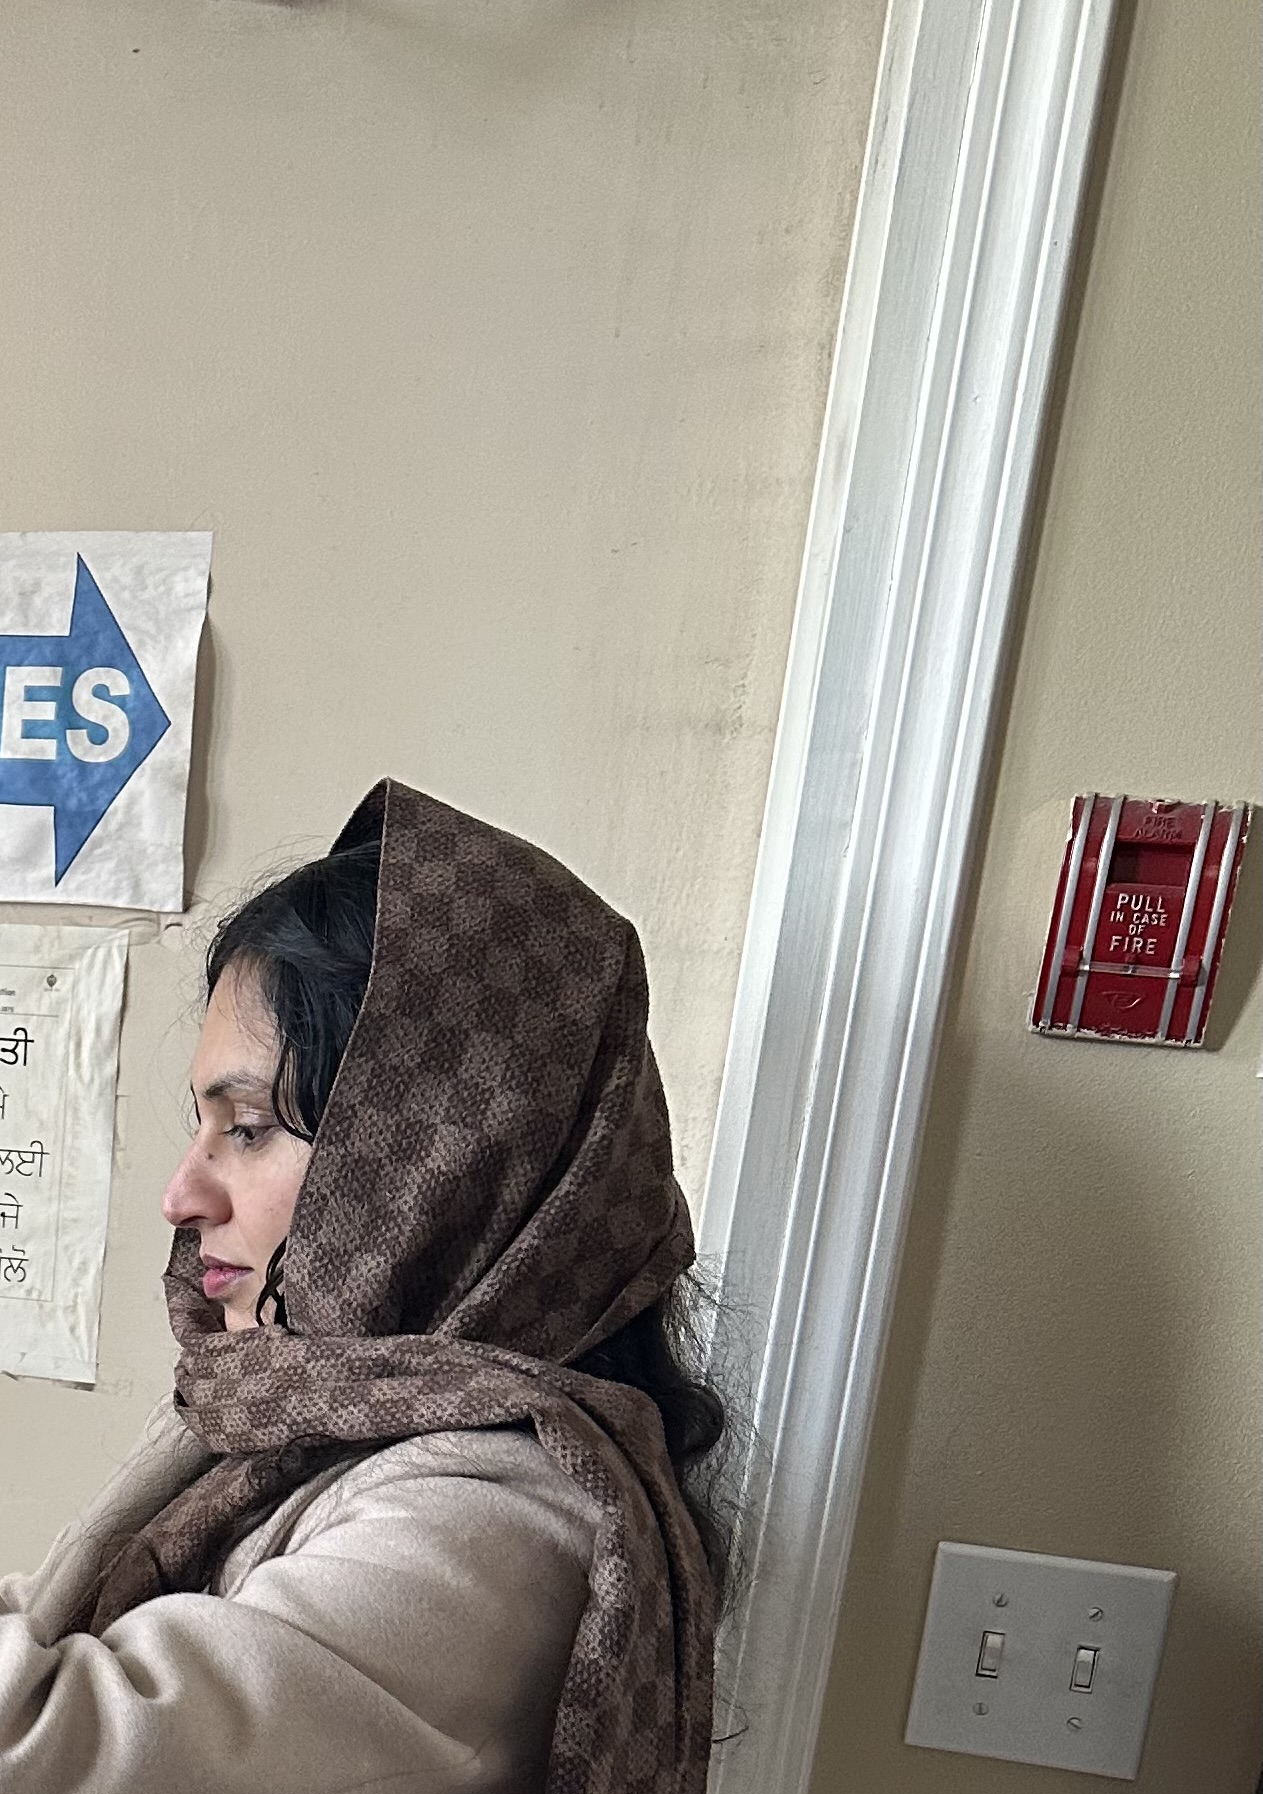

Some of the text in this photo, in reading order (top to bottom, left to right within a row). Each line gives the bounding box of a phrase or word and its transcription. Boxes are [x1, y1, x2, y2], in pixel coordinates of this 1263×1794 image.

[1116, 893, 1166, 913] PULL
[1110, 911, 1168, 926] IN CASE
[1128, 924, 1146, 935] OF
[1109, 936, 1157, 955] FIRE
